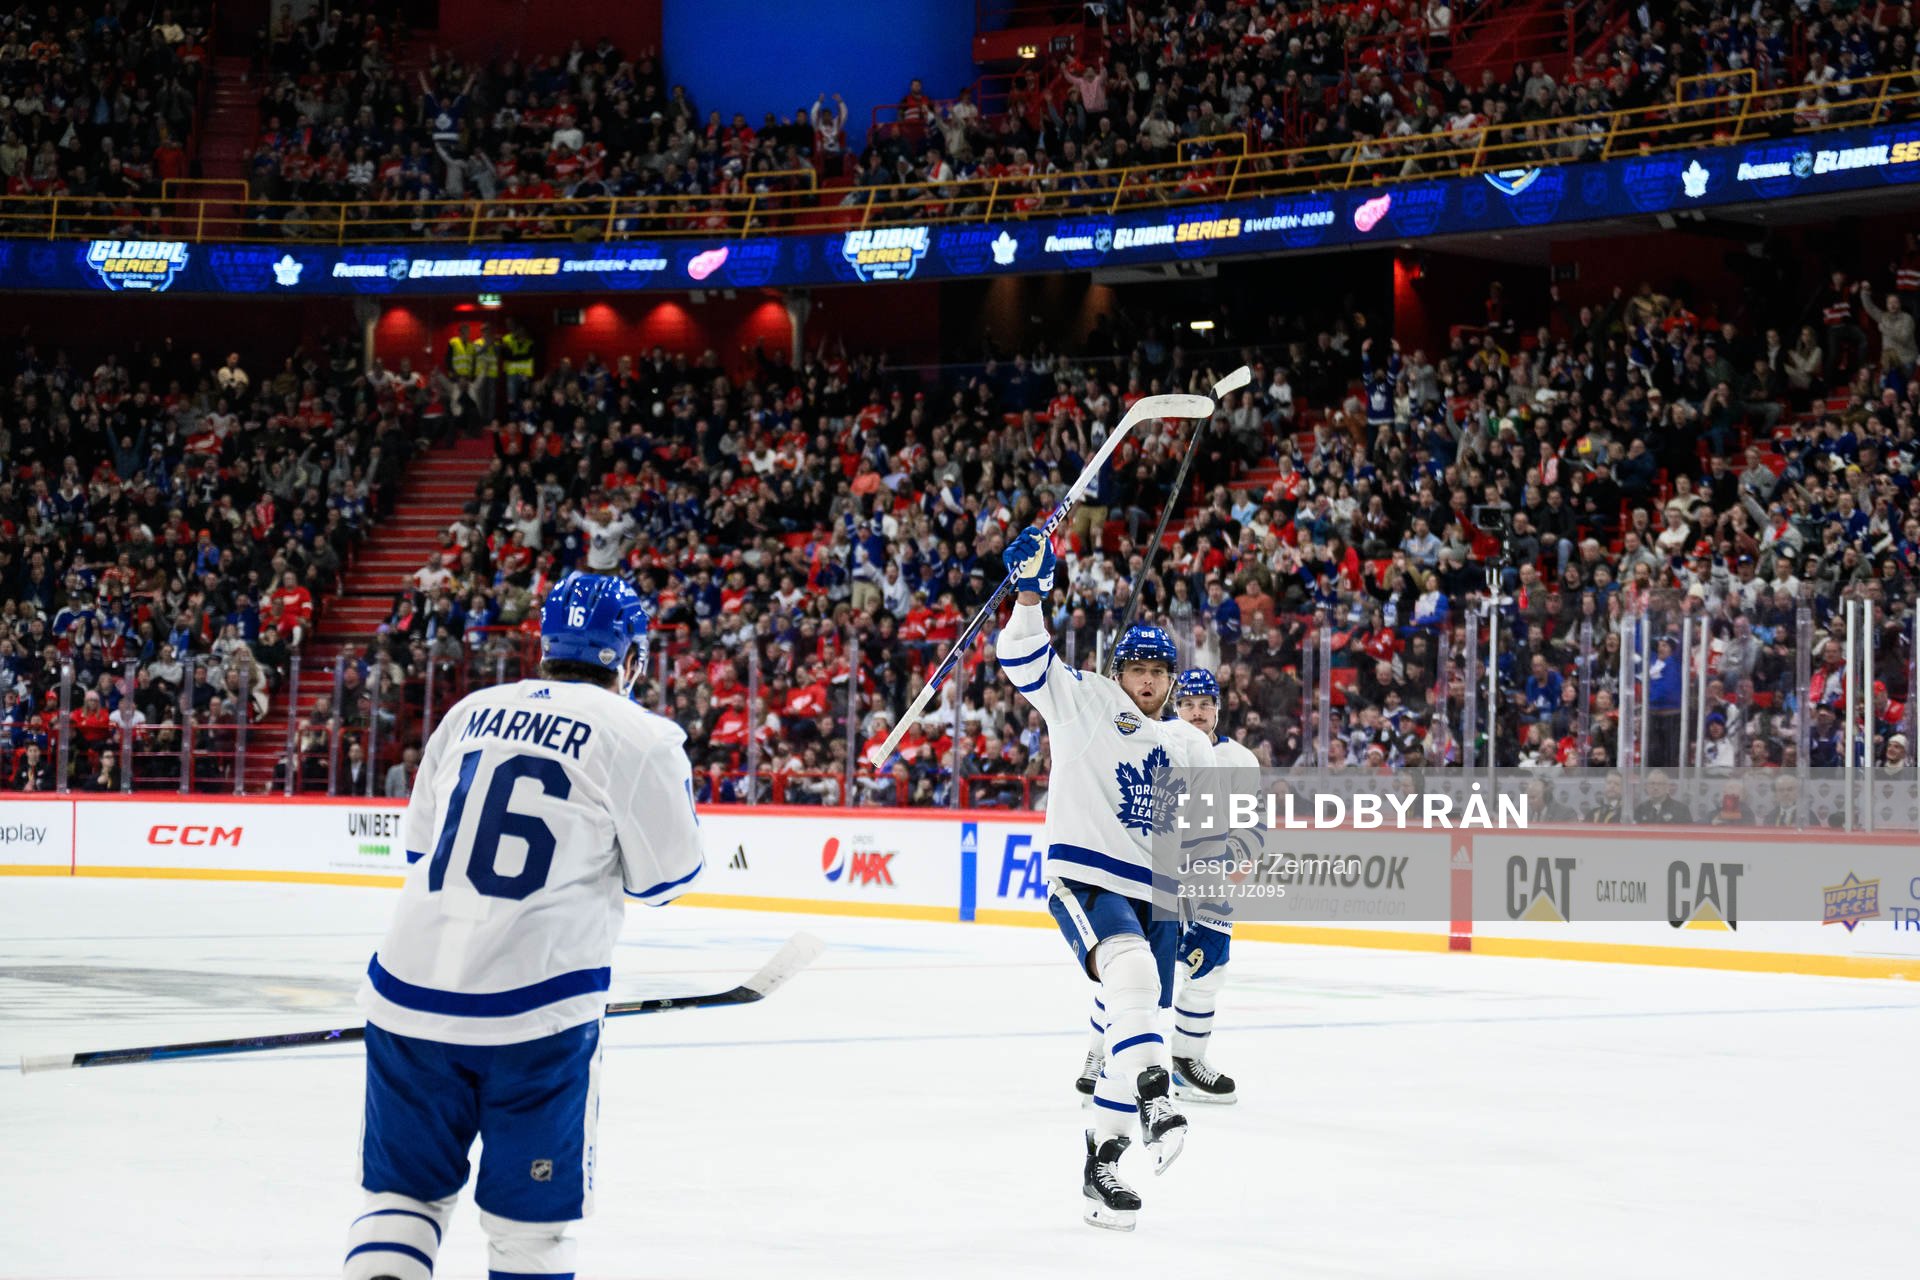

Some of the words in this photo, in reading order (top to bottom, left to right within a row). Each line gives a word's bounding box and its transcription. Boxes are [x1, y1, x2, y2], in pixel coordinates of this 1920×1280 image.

[1813, 145, 1889, 174] GLOBAL
[846, 227, 929, 254] GLOBAL
[1113, 225, 1175, 250] GLOBAL
[1175, 218, 1241, 242] SERIES
[91, 241, 186, 262] GLOBAL
[857, 248, 912, 264] SERIES
[103, 259, 169, 272] SERIES
[408, 259, 483, 278] GLOBAL
[483, 258, 559, 276] SERIES
[568, 606, 586, 628] 16
[460, 708, 592, 760] MARNER
[1127, 784, 1176, 806] TORONTO
[1133, 795, 1168, 812] MAPLE
[348, 813, 400, 837] UNIBET
[428, 749, 572, 901] 16
[1130, 805, 1166, 821] LEAFS
[148, 825, 242, 847] CCM
[848, 850, 897, 887] MAX
[1506, 855, 1576, 923] CAT
[1596, 880, 1647, 904] CAT.COM
[1667, 861, 1744, 932] CAT
[1825, 887, 1876, 905] UPPER
[1288, 893, 1337, 917] driving
[1343, 896, 1406, 915] emotion
